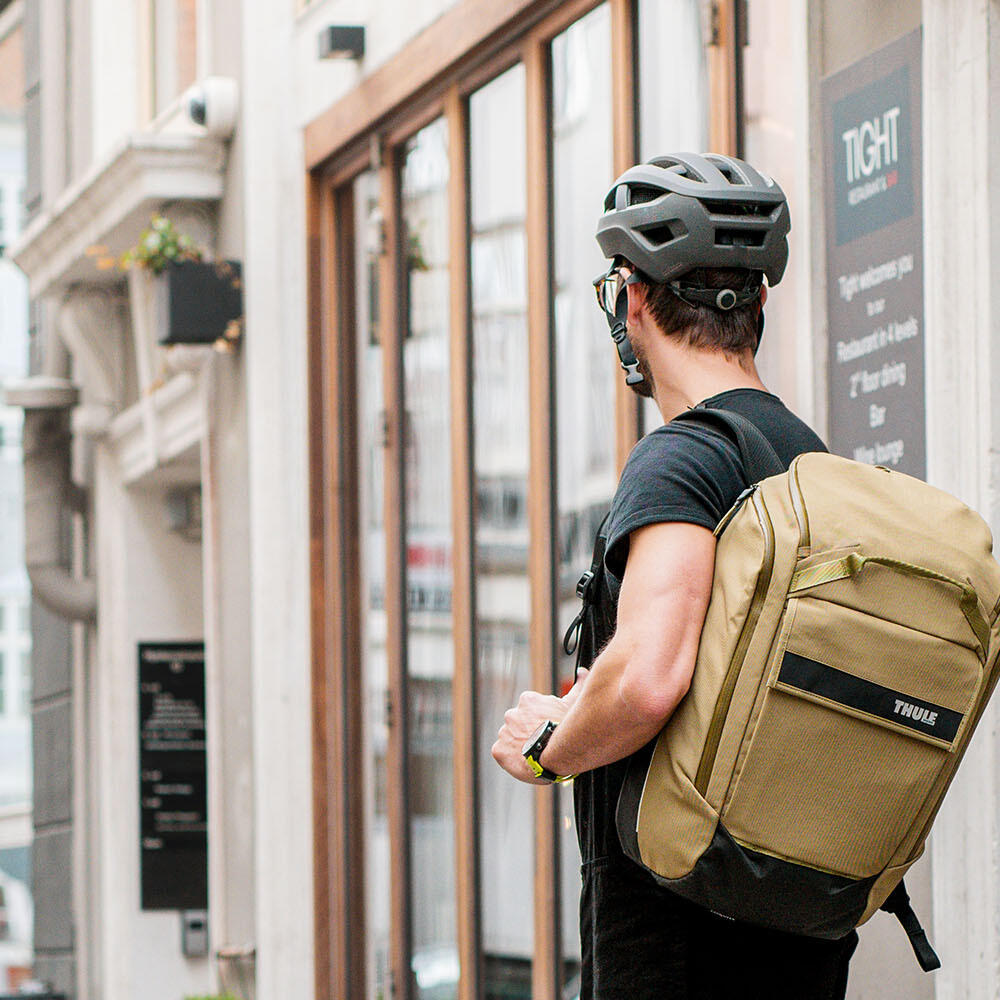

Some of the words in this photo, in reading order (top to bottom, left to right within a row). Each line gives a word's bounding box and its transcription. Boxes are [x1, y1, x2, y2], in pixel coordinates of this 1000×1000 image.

[842, 106, 901, 183] TIGHT
[869, 404, 886, 428] Bar
[894, 699, 938, 726] THULE
